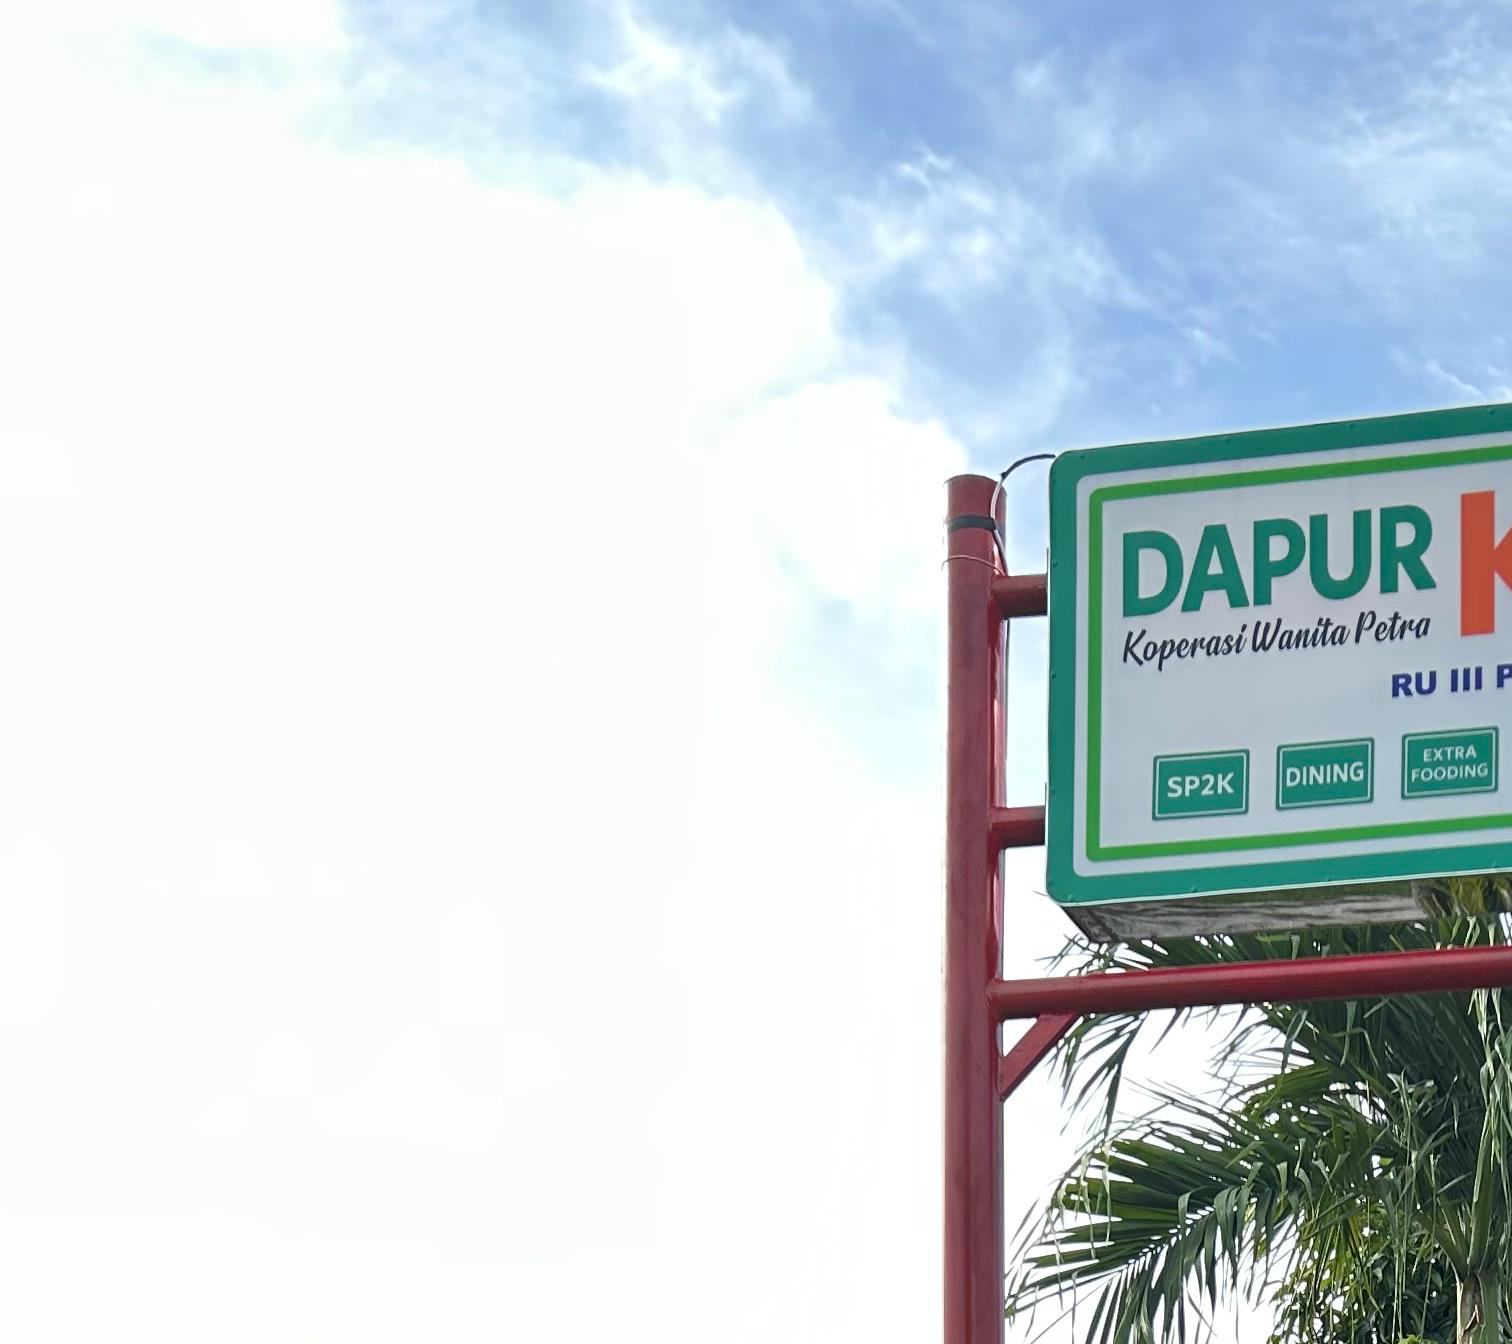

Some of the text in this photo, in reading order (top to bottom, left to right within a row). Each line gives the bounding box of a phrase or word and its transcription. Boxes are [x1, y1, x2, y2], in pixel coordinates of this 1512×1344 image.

[1122, 503, 1437, 618] DAPUR
[1122, 609, 1432, 672] Koperasi Wanita Petra
[1391, 669, 1438, 699] RU
[1449, 665, 1484, 693] III
[1422, 743, 1478, 764] EXTRA
[1166, 771, 1235, 799] SP2K
[1285, 760, 1365, 788] DINING
[1410, 762, 1489, 784] FOODING
